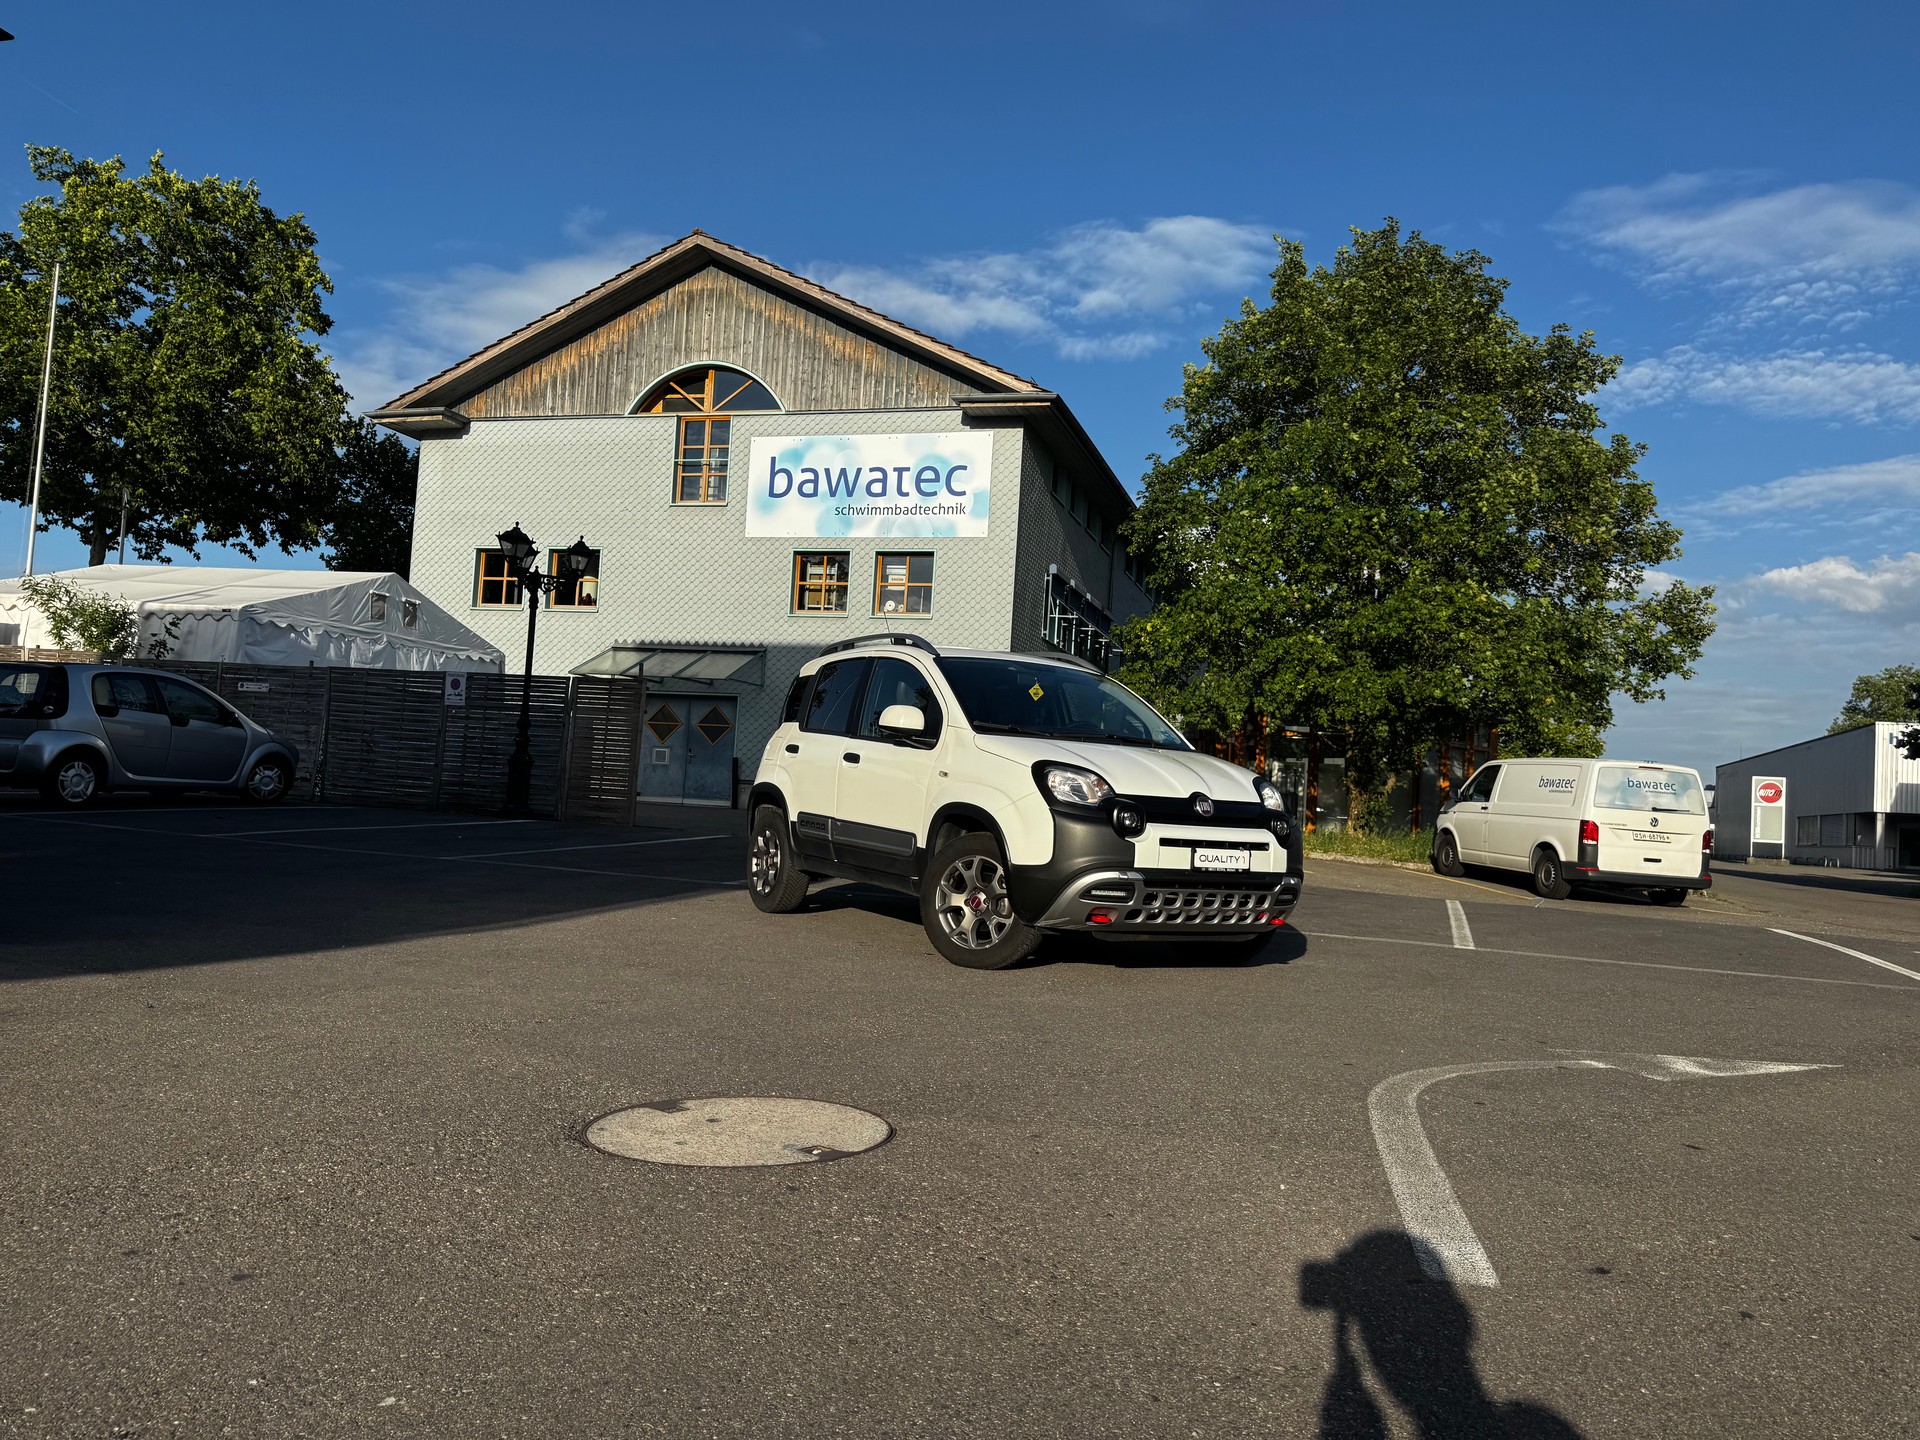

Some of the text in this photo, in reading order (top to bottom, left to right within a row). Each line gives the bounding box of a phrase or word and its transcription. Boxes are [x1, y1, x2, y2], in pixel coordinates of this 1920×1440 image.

[768, 456, 968, 498] bawatec
[834, 503, 966, 516] schwimmbadtechnik
[1538, 775, 1576, 788] bawatec
[1627, 777, 1677, 791] bawatec
